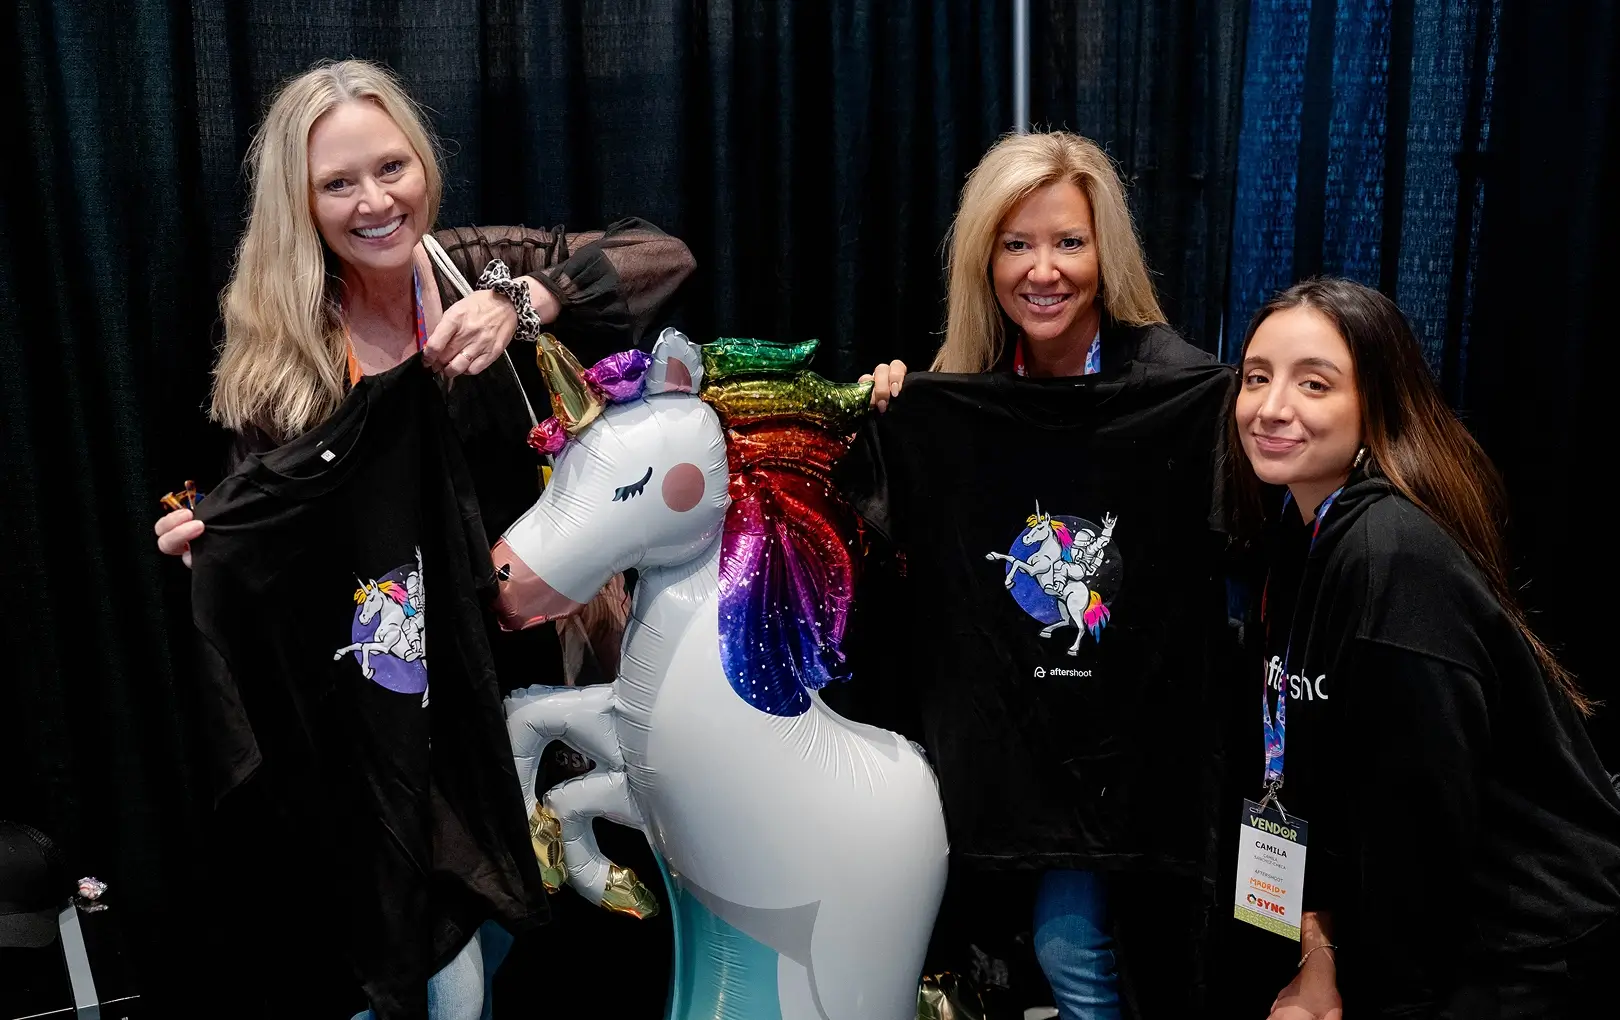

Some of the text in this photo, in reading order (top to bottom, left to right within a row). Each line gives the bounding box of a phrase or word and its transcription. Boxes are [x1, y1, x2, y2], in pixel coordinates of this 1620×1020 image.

[1050, 667, 1092, 677] aftershoot
[1250, 815, 1297, 841] VENDOR
[1255, 841, 1287, 858] CAMILA
[1254, 869, 1284, 883] AFTERSHOOT
[1249, 877, 1280, 893] MADRID
[1257, 898, 1285, 915] SYNC
